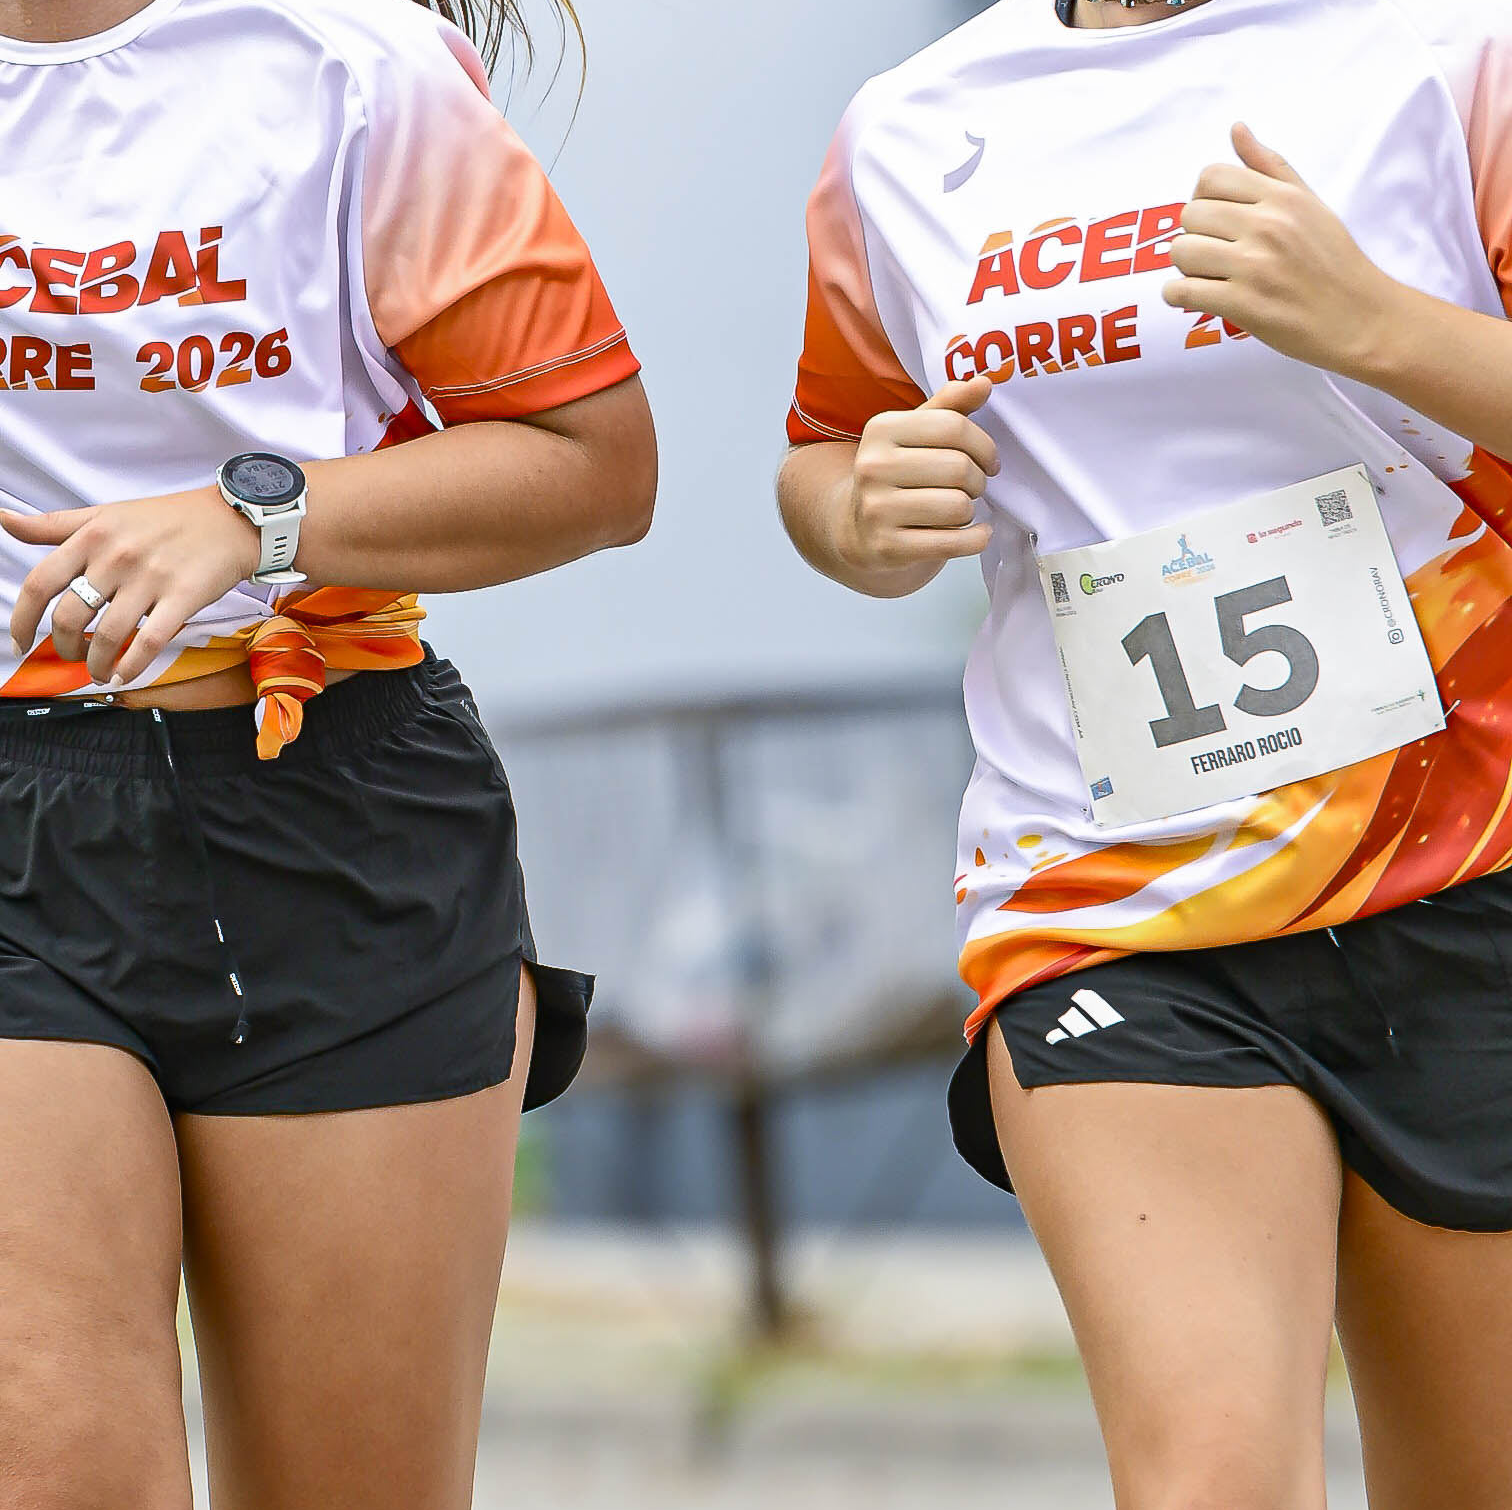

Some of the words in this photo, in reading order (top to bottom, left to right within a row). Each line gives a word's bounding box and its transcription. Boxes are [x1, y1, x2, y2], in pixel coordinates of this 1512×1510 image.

[966, 202, 1189, 306] ACEB
[135, 326, 292, 393] 2026
[944, 304, 1142, 386] CORRE
[1121, 575, 1320, 749] 15
[1190, 740, 1257, 775] FERRARO
[1256, 726, 1304, 757] ROCIO
